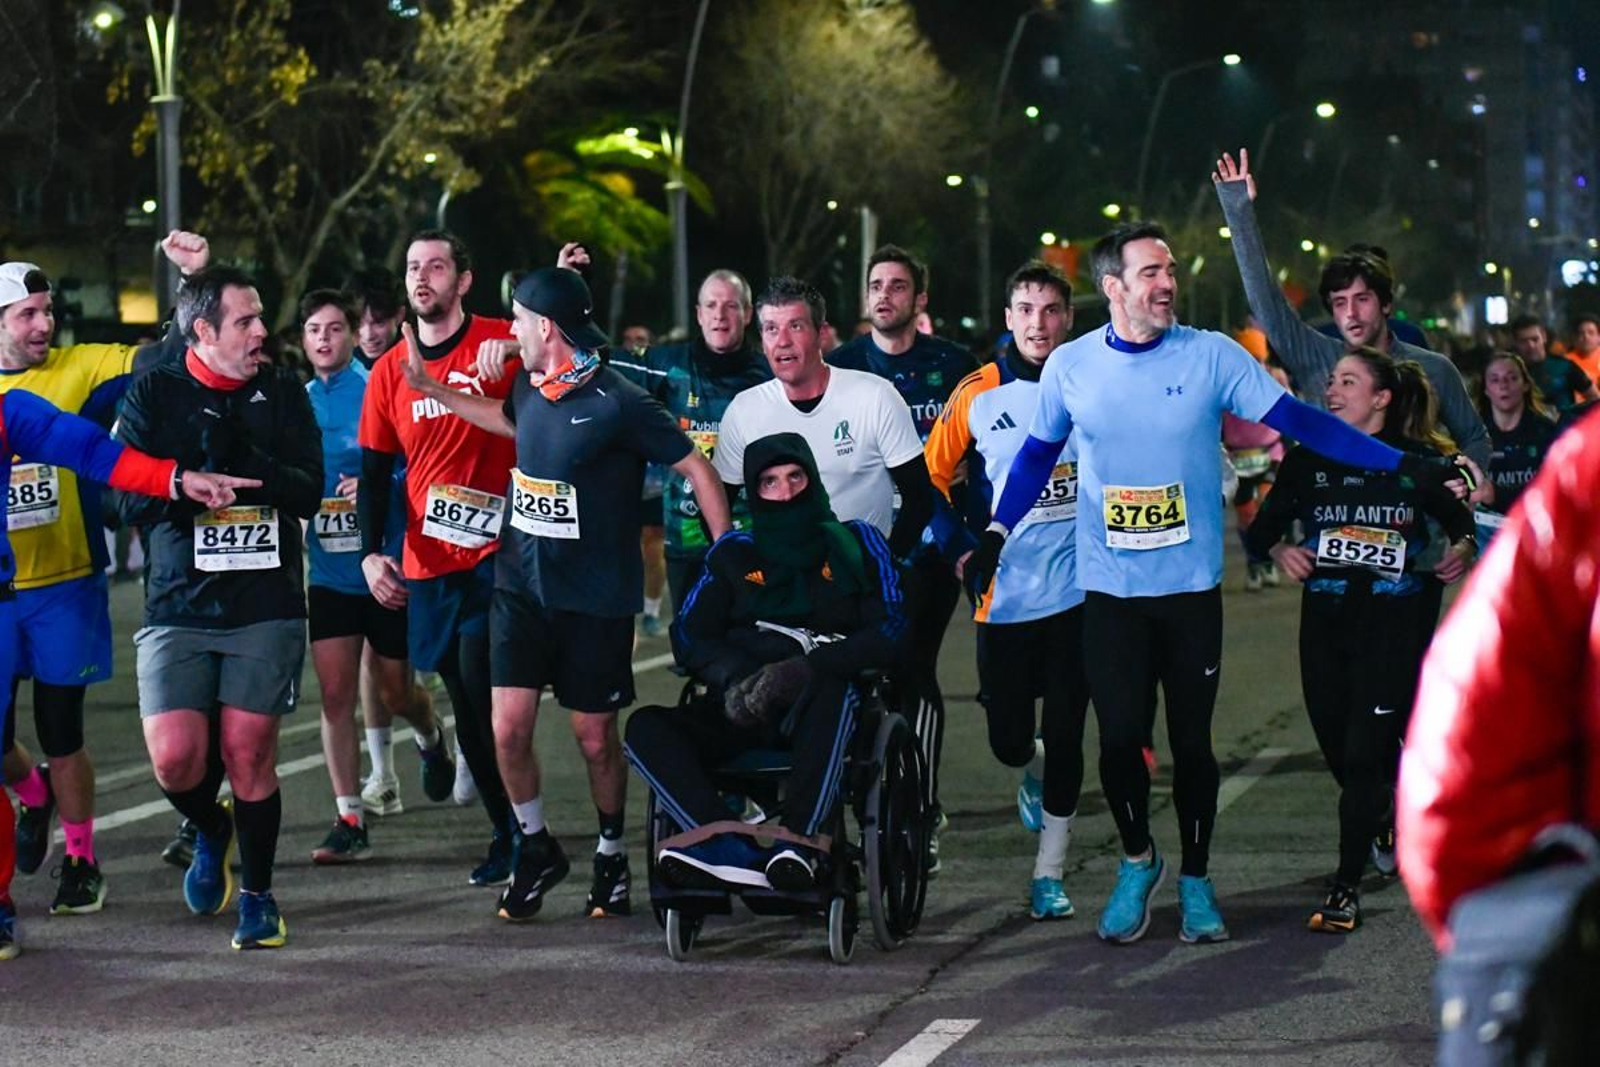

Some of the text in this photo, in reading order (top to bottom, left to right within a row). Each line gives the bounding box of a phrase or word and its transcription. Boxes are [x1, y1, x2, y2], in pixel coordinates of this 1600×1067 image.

[432, 498, 497, 530] 8677
[516, 488, 570, 517] 8265
[1110, 500, 1180, 526] 3764
[1313, 501, 1414, 525] SAN ANTÓN
[202, 523, 272, 548] 8472
[1325, 538, 1397, 566] 8525
